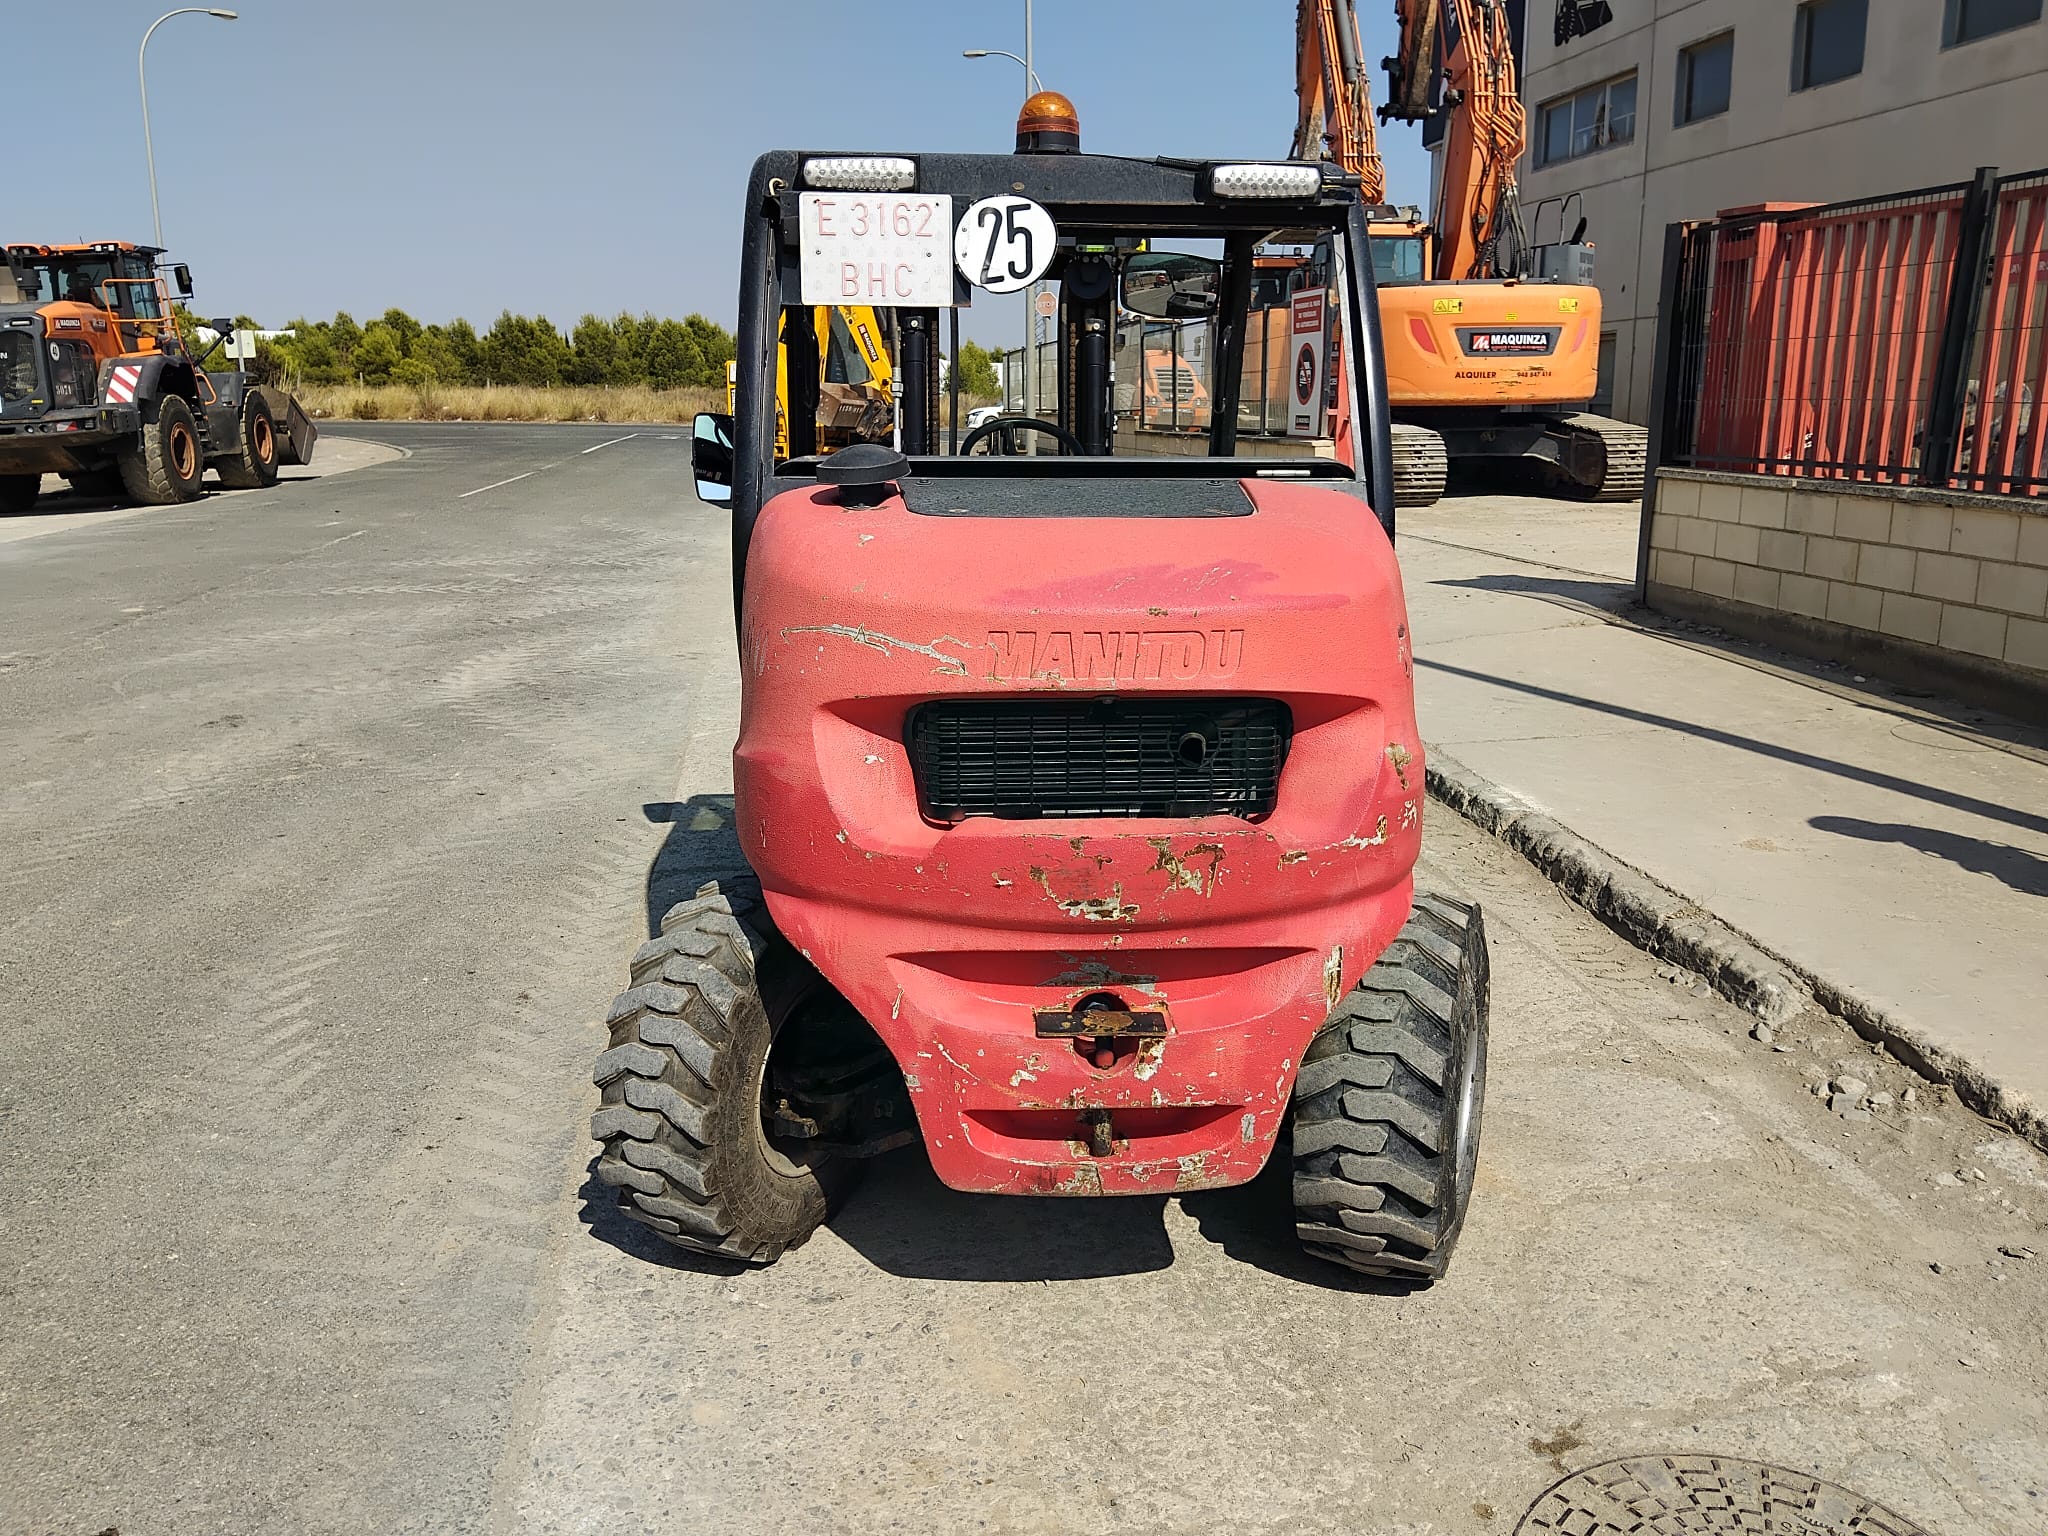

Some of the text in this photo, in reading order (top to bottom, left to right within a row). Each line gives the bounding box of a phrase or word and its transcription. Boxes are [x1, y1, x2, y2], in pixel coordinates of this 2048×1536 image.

[817, 201, 933, 237] E 3162
[977, 203, 1033, 284] 25
[840, 262, 913, 297] BHC
[1490, 334, 1547, 345] MAQUINZA
[1455, 371, 1497, 379] ALQUILER
[982, 630, 1245, 680] MANITOU
